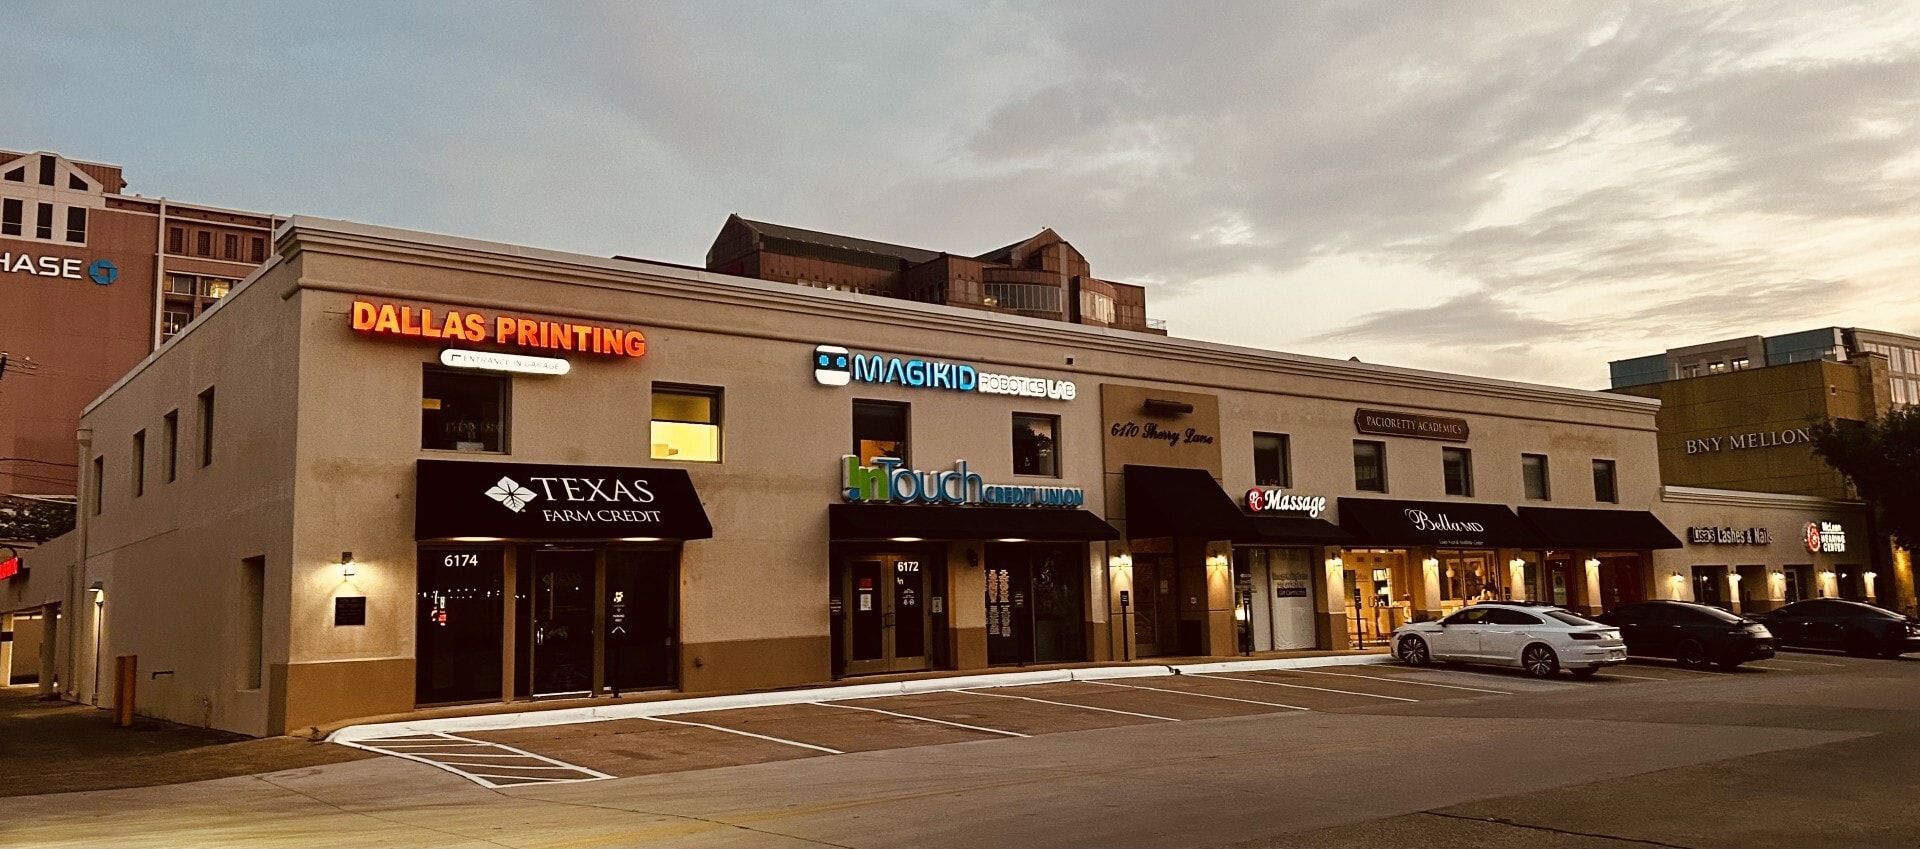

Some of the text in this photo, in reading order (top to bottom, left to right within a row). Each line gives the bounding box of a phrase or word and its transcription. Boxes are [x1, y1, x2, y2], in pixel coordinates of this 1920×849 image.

[352, 300, 647, 358] DALLAS PRINTING
[462, 355, 509, 366] ENTRANCE
[524, 361, 560, 371] GARAGE
[854, 353, 1077, 400] MAGIKID ROBOTICS LAB
[1111, 421, 1214, 447] 6170 Sherry Lane
[1366, 415, 1463, 435] PACIORETTY ACADEMICS
[1686, 427, 1811, 454] BNY MELLON
[530, 476, 655, 503] TEXAS
[983, 484, 1037, 505] CREDIT
[1039, 487, 1084, 508] UNION
[542, 509, 661, 522] FARM CREDIT
[1264, 489, 1327, 518] Massage
[1717, 527, 1746, 544] Lashes
[1746, 530, 1753, 544] &
[444, 554, 479, 567] 6174
[897, 561, 919, 572] 6172
